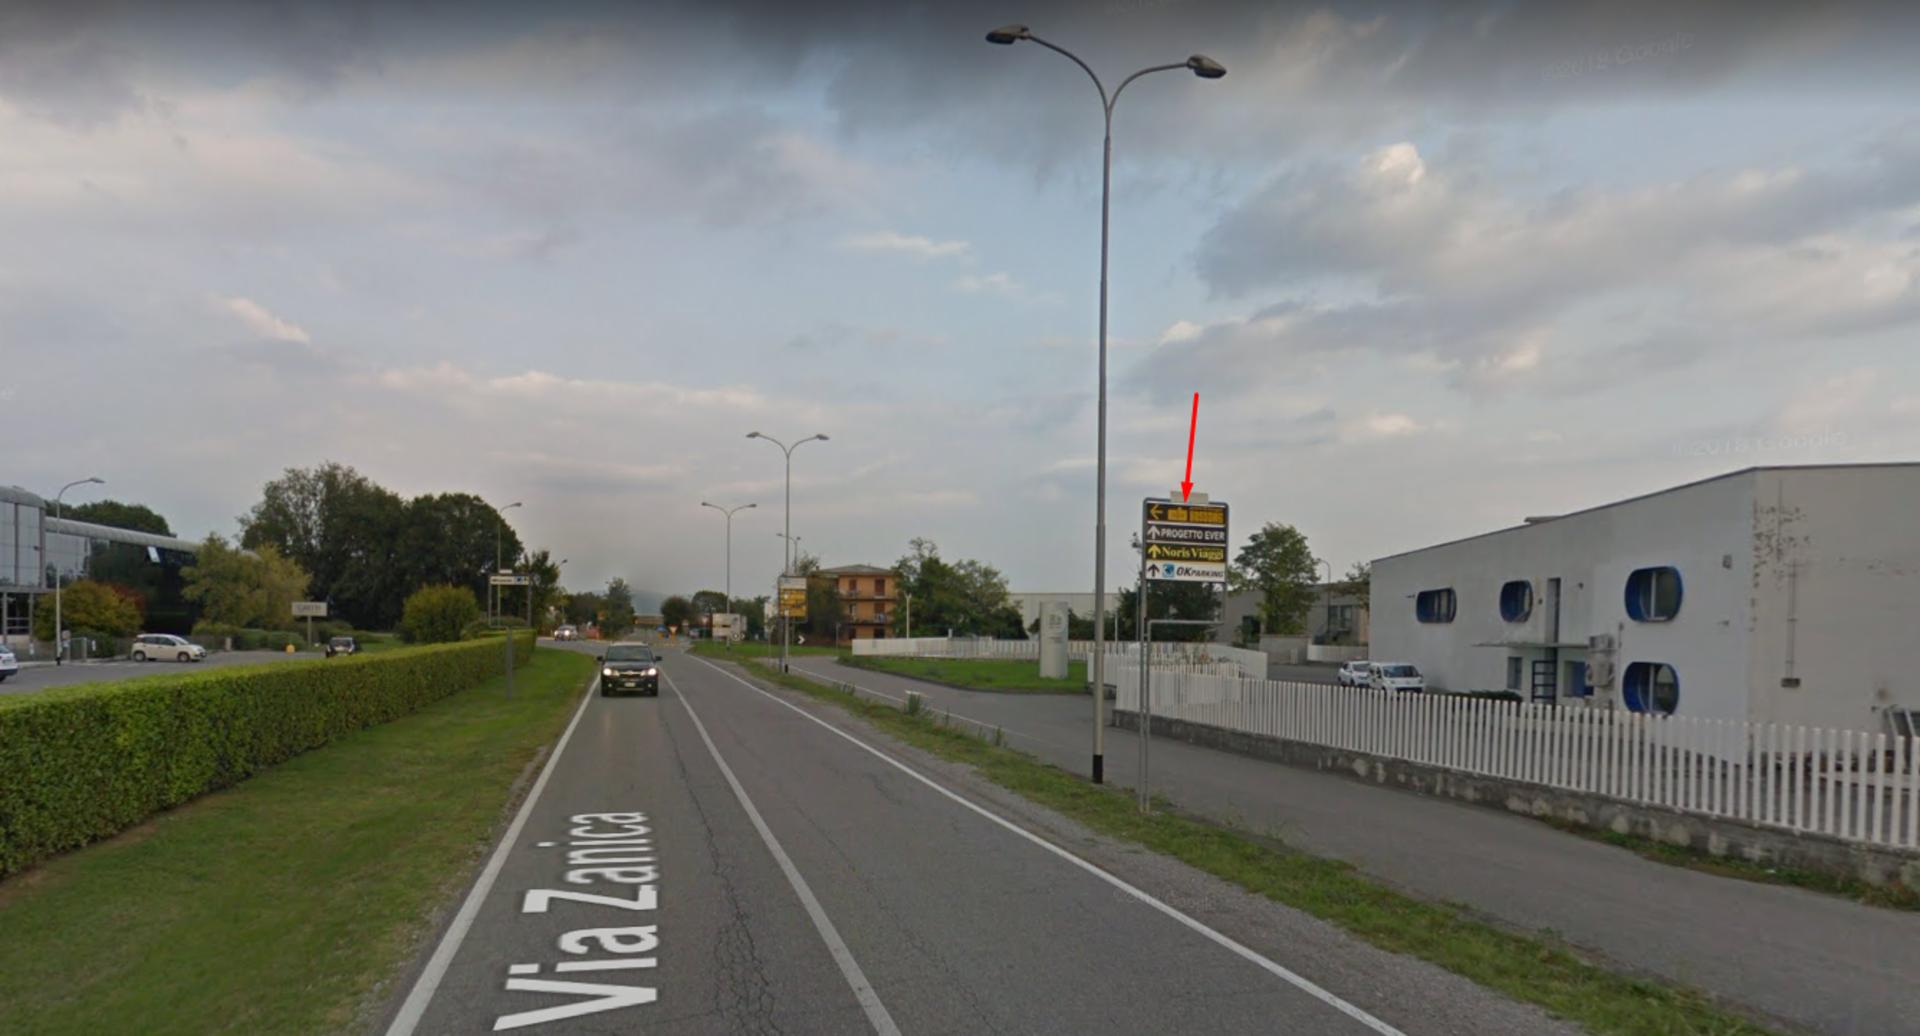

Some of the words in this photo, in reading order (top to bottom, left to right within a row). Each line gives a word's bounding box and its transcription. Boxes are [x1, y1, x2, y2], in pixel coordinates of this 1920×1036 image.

[1161, 528, 1203, 540] PROGETTO
[1204, 531, 1225, 541] EVER
[1162, 546, 1190, 558] Noris
[1190, 548, 1224, 560] Viaggi
